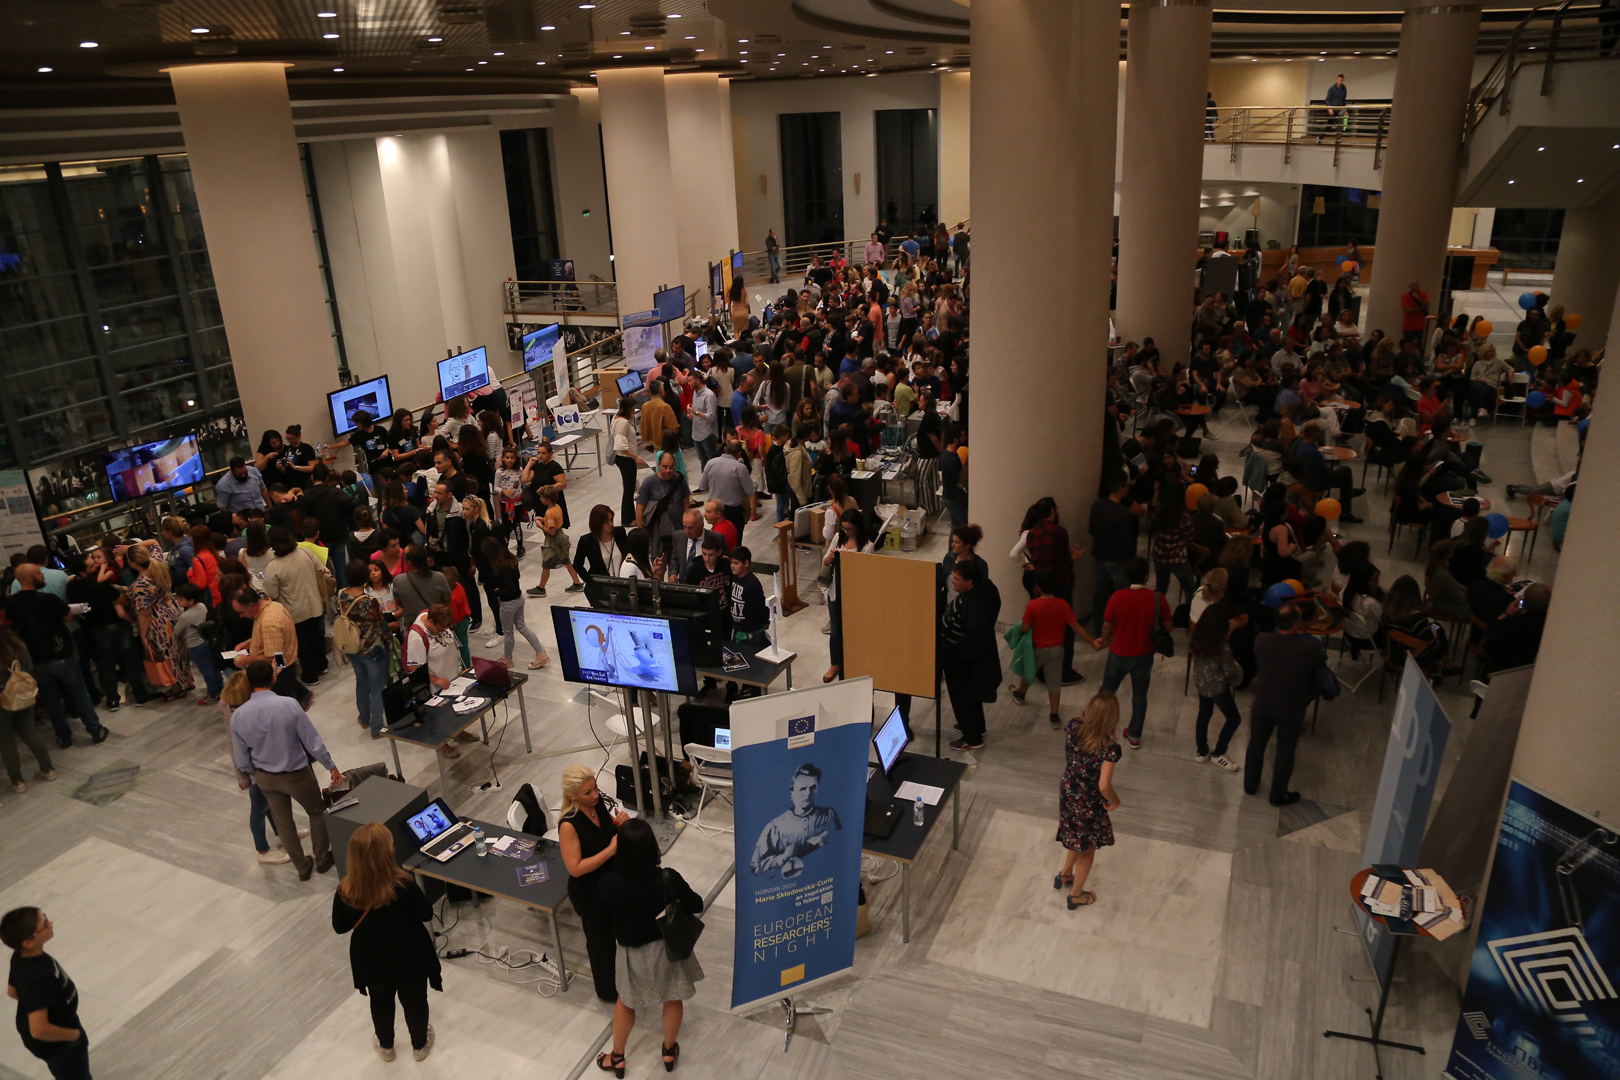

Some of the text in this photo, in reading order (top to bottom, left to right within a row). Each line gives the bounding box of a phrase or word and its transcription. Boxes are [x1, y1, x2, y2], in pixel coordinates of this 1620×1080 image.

[755, 882, 797, 896] HORIZON 2020
[804, 885, 833, 898] inspiration
[755, 895, 775, 904] Marie
[803, 896, 820, 904] follow
[754, 903, 833, 937] EUROPEAN
